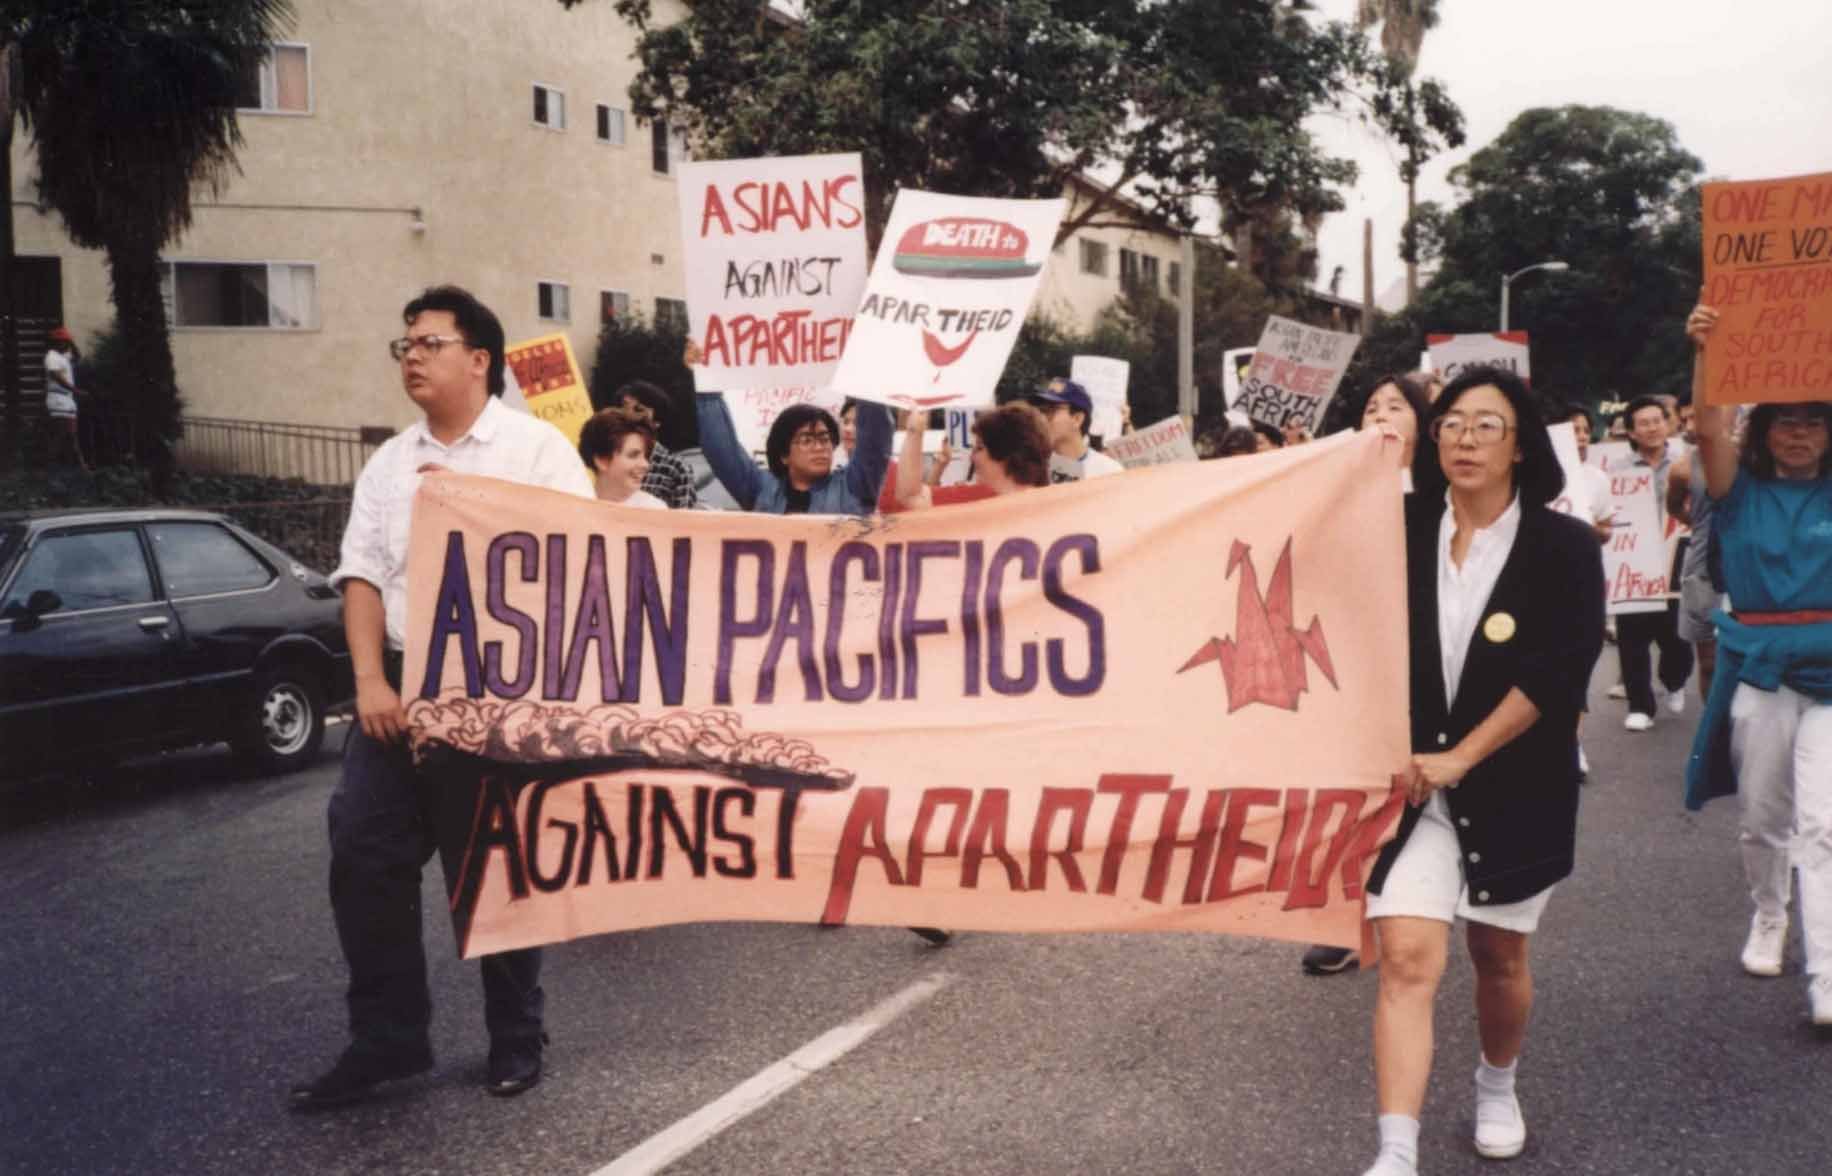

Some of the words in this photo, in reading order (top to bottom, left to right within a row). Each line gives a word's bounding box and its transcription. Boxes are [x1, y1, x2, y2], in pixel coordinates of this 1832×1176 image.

[700, 174, 863, 238] ASIANS
[1712, 186, 1783, 222] ONE
[921, 223, 1001, 248] DEATH
[1713, 229, 1778, 265] ONE
[1790, 226, 1832, 260] VO
[722, 257, 842, 299] AGAINST
[1707, 267, 1832, 307] DEMOCRA
[1754, 303, 1807, 330] FOR
[700, 311, 857, 368] APARTHEI
[1246, 377, 1324, 408] SOUTH
[1247, 351, 1337, 397] FREE
[420, 530, 691, 706] ASIAN
[712, 533, 1106, 704] PACIFICS
[453, 770, 820, 957] AGAINST
